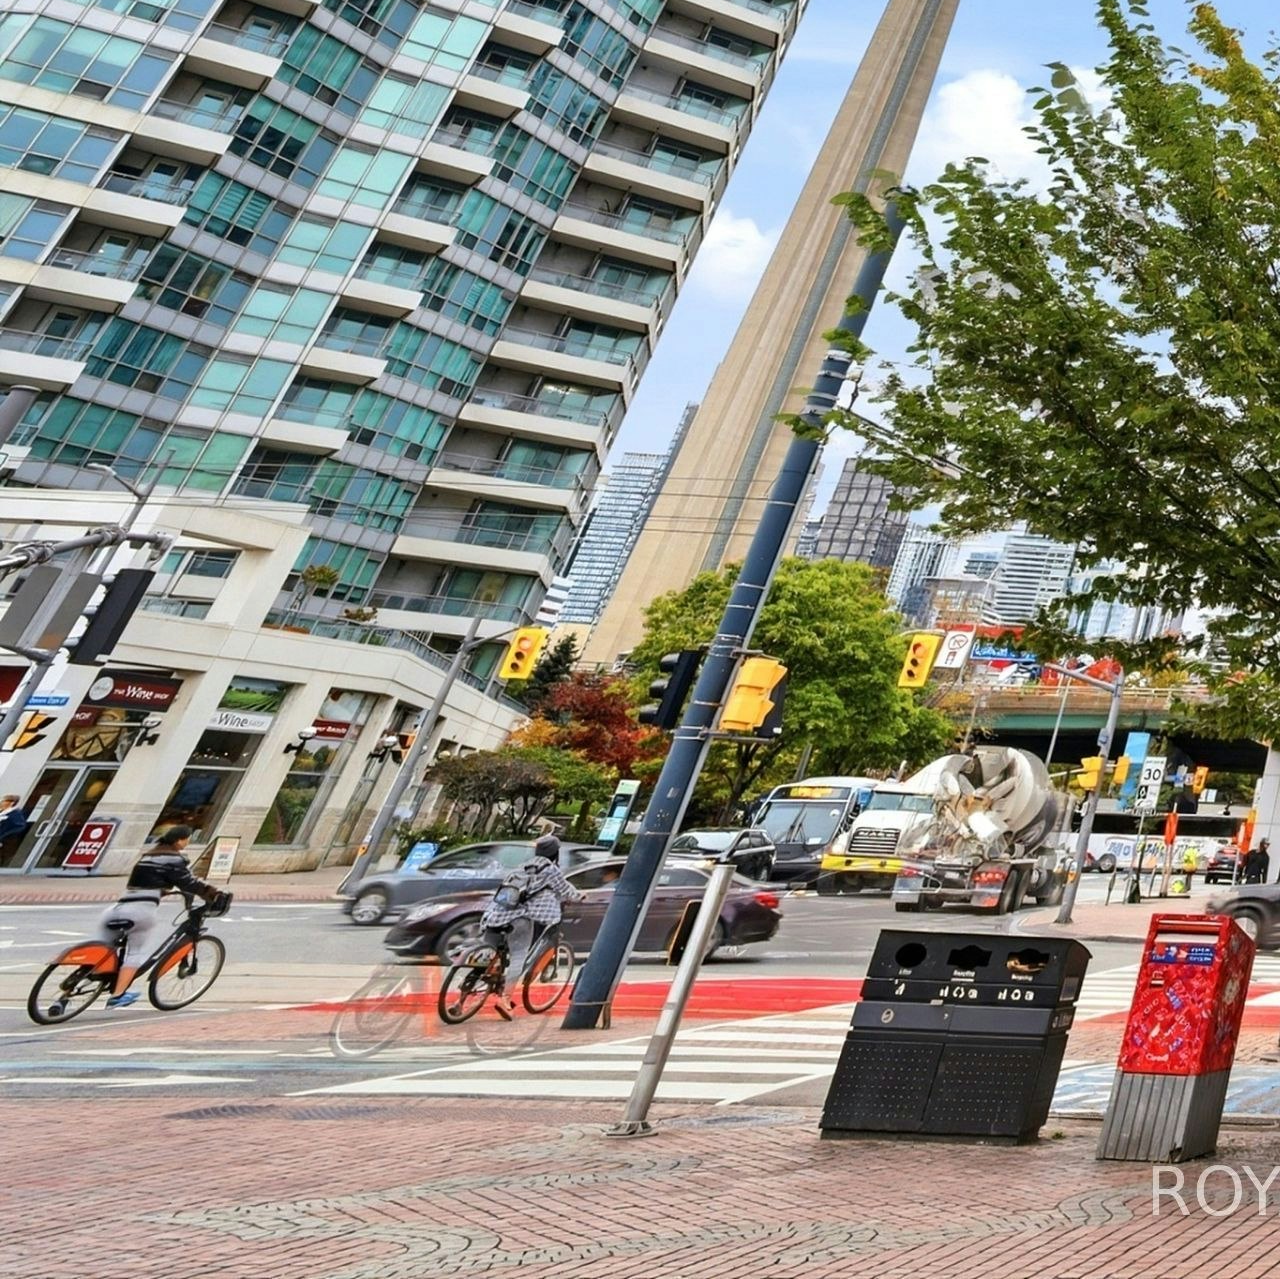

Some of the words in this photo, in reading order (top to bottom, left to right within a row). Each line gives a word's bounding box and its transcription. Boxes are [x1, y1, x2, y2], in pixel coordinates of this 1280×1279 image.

[126, 685, 154, 700] Wine
[217, 712, 249, 728] Wine
[1143, 768, 1161, 781] 30
